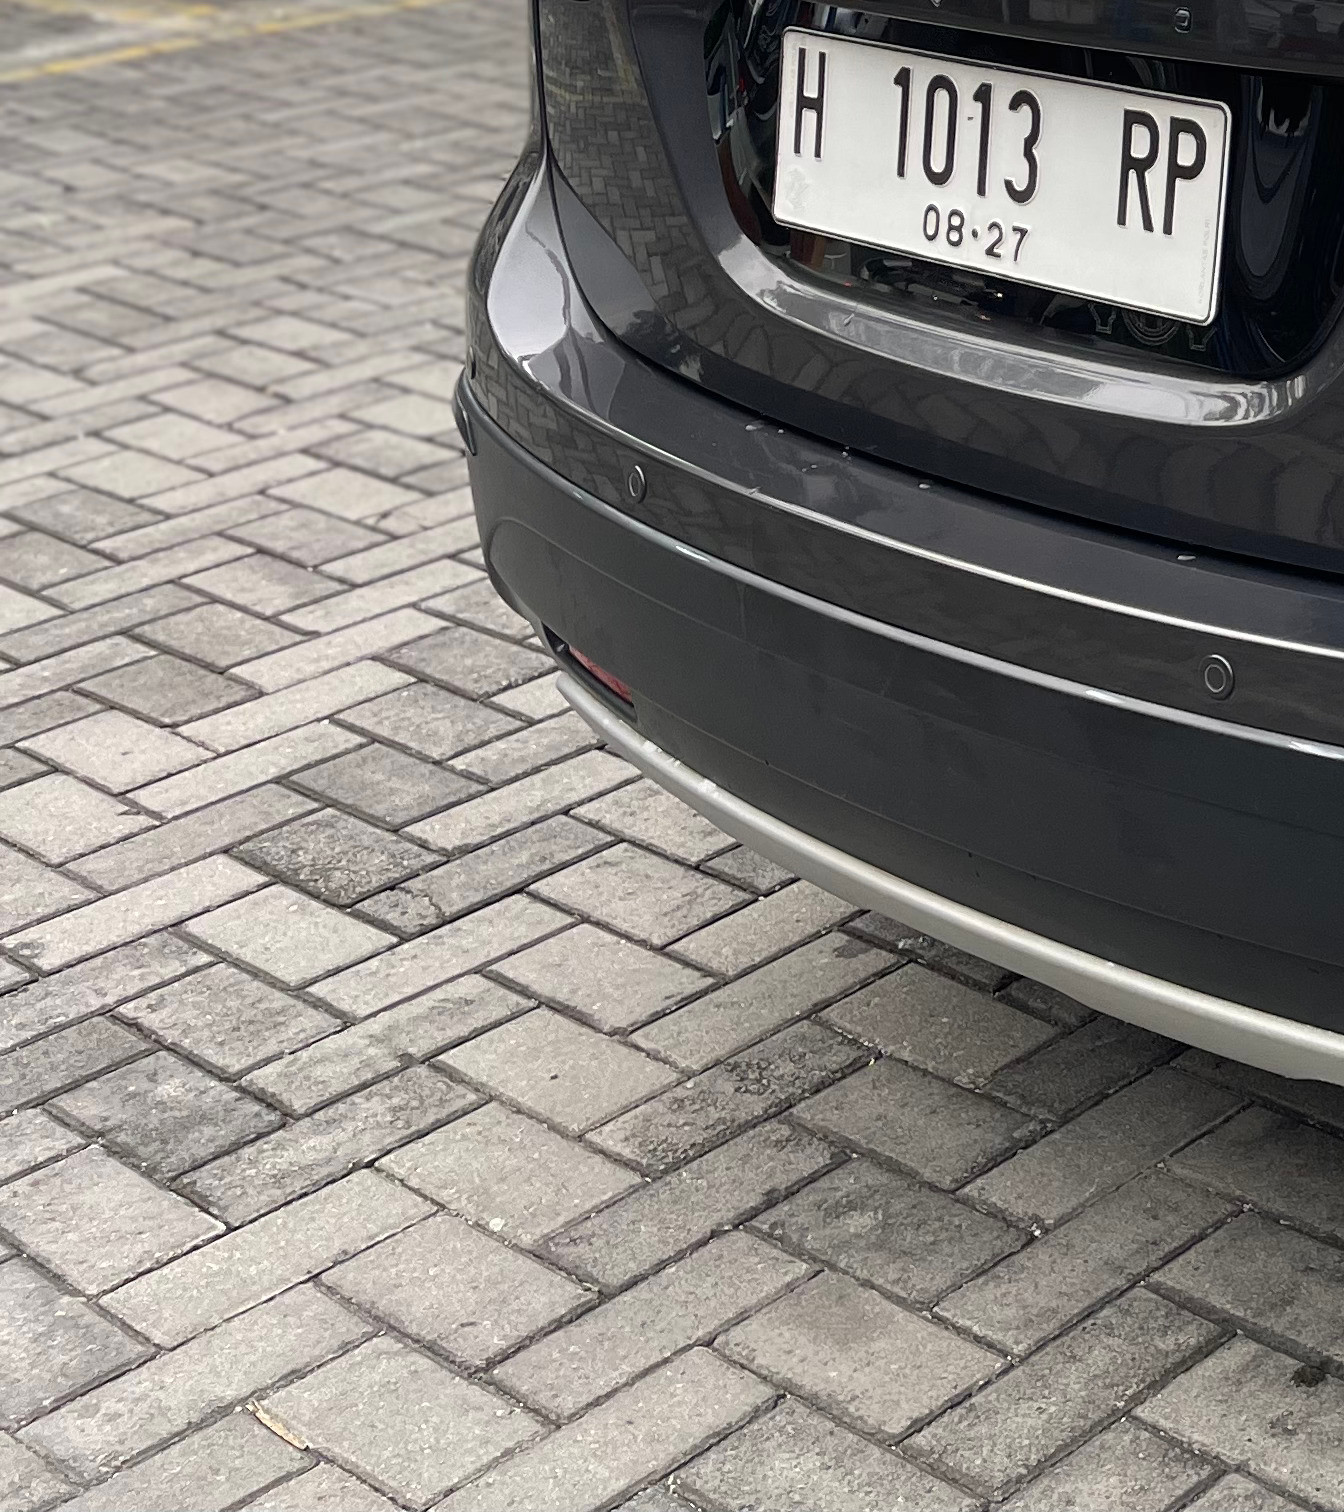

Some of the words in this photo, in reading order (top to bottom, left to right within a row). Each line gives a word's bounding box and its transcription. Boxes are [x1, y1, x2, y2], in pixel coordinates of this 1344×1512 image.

[793, 47, 827, 160] H
[893, 65, 1042, 205] 1013
[1116, 107, 1208, 237] RP
